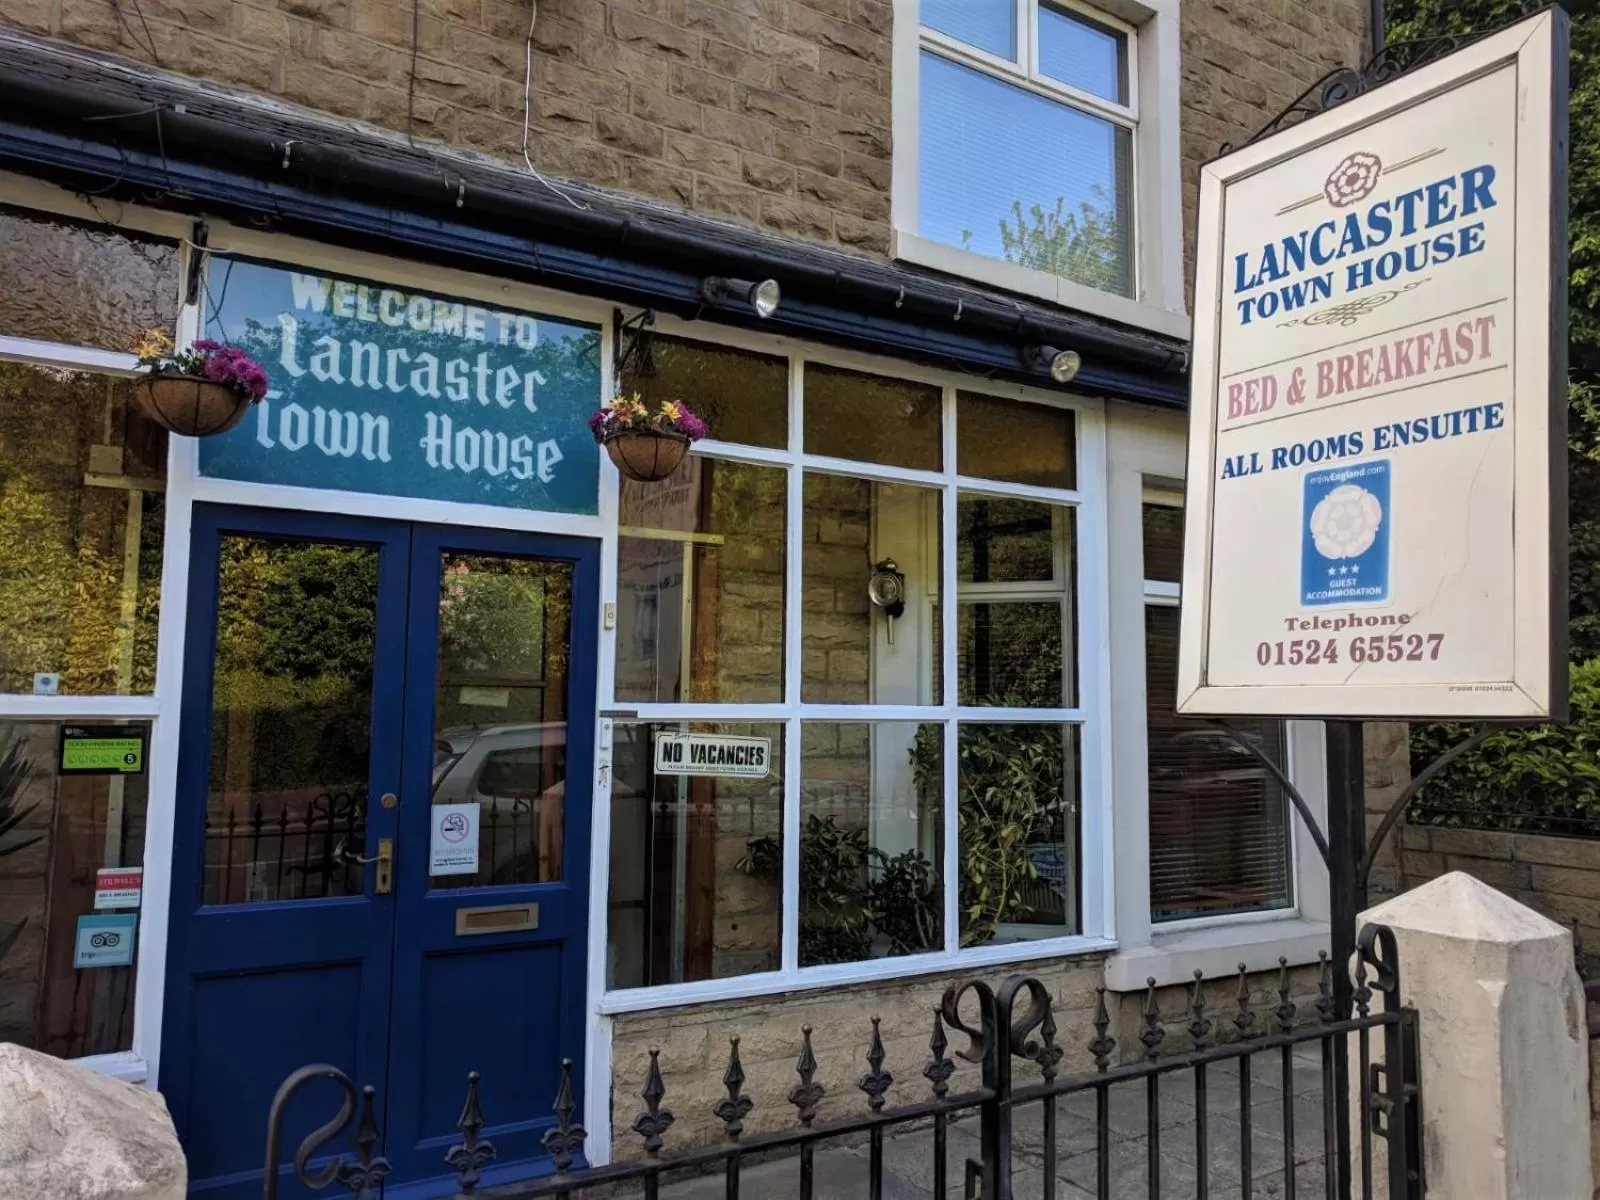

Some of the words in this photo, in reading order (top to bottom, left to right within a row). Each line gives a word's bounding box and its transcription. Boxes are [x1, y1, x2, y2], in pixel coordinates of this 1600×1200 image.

[1234, 164, 1498, 293] LANCASTER
[290, 272, 485, 341] WELCOME
[491, 311, 537, 350] TO
[1237, 273, 1333, 325] TOWN
[1346, 222, 1486, 292] HOUSE
[276, 312, 547, 413] Lancaster
[1227, 374, 1277, 420] BED
[1286, 367, 1306, 406] &
[1316, 315, 1496, 399] BREAKFAST
[256, 390, 392, 463] Town
[420, 411, 564, 483] House
[1221, 452, 1263, 480] ALL
[1272, 431, 1364, 470] ROOMS
[1373, 402, 1505, 451] ENSUITE
[1310, 466, 1385, 484] enjoyEngland.com
[1285, 611, 1411, 631] Telephone
[1306, 587, 1382, 600] ACCOMMODATION
[1329, 578, 1357, 588] GUEST
[1257, 638, 1338, 666] 01524
[1350, 633, 1445, 663] 65527
[663, 742, 683, 763] NO
[690, 743, 765, 766] VACANCIES
